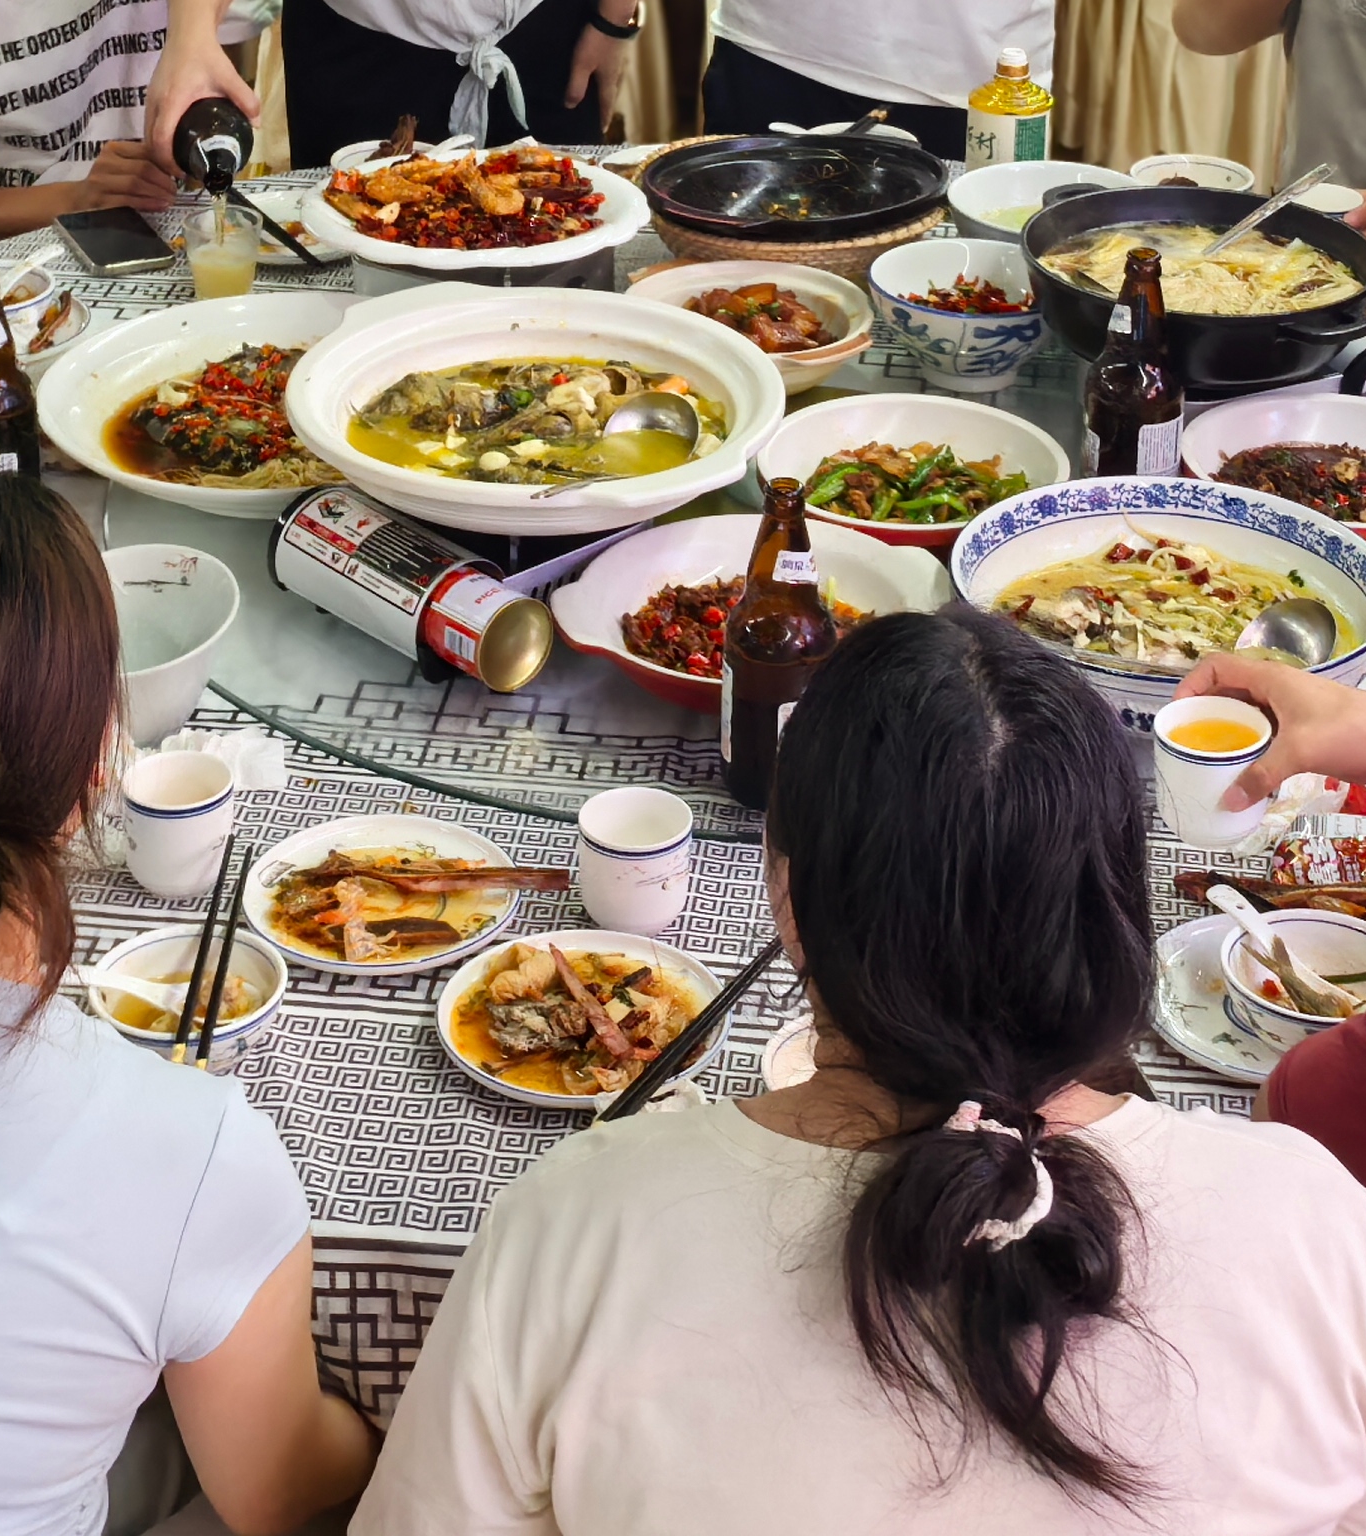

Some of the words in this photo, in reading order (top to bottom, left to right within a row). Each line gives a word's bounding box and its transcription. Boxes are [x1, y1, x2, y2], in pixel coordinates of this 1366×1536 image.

[27, 20, 79, 56] ORDER
[80, 9, 97, 32] OF
[22, 69, 78, 107] MAKES
[79, 31, 149, 85] EERYTHING
[83, 87, 136, 129] IVISIBLE
